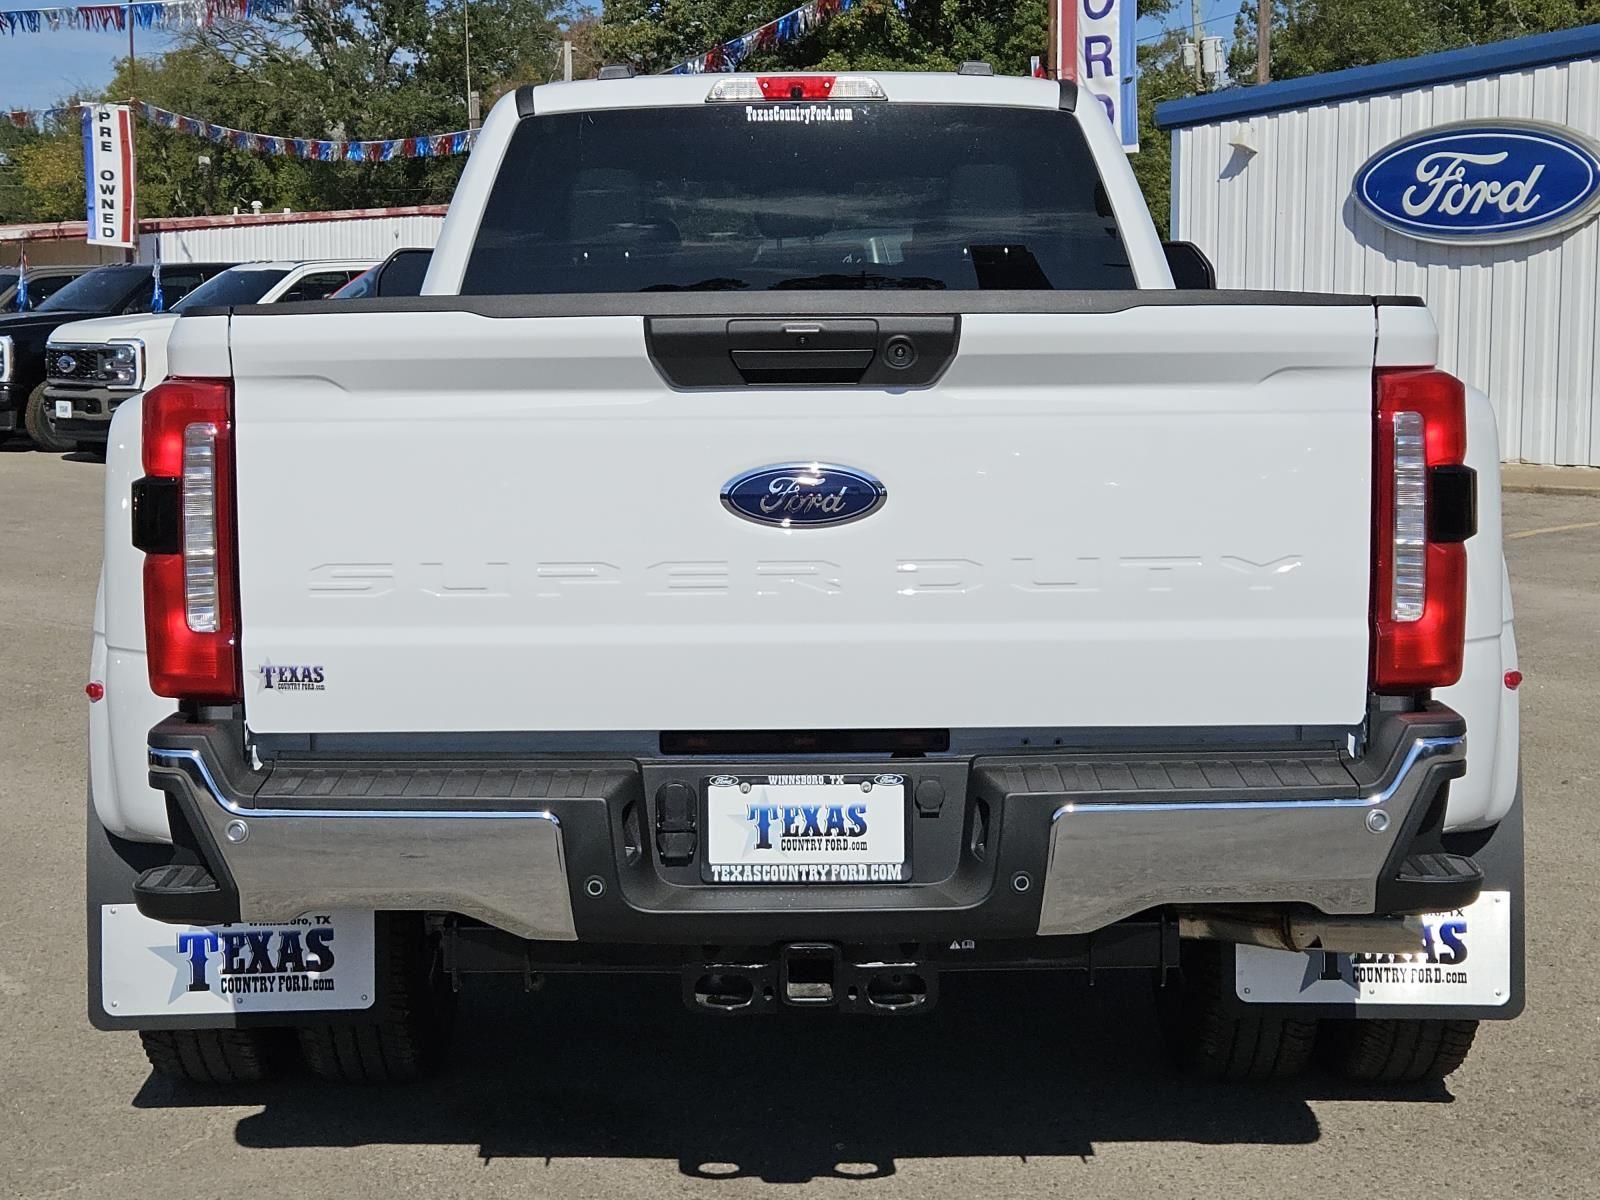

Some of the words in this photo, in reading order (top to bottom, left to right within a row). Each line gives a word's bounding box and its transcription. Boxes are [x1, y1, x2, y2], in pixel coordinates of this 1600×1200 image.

[98, 111, 113, 152] PRE
[1402, 151, 1545, 217] Ford
[99, 169, 116, 238] OWNED
[759, 476, 848, 513] Ford
[308, 560, 842, 599] SUPER
[895, 555, 1303, 595] DUTY
[259, 665, 325, 689] TEXAS
[829, 775, 845, 785] TX
[747, 803, 868, 850] TEXAS
[781, 838, 823, 851] COUNTRY
[825, 838, 868, 851] FORD.com
[314, 915, 332, 925] TX
[176, 927, 335, 992] TEXAS
[1352, 966, 1407, 984] COUNTRY
[1410, 966, 1468, 984] FORD.com
[220, 975, 274, 994] COUNTRY
[278, 973, 335, 992] FORD.com
